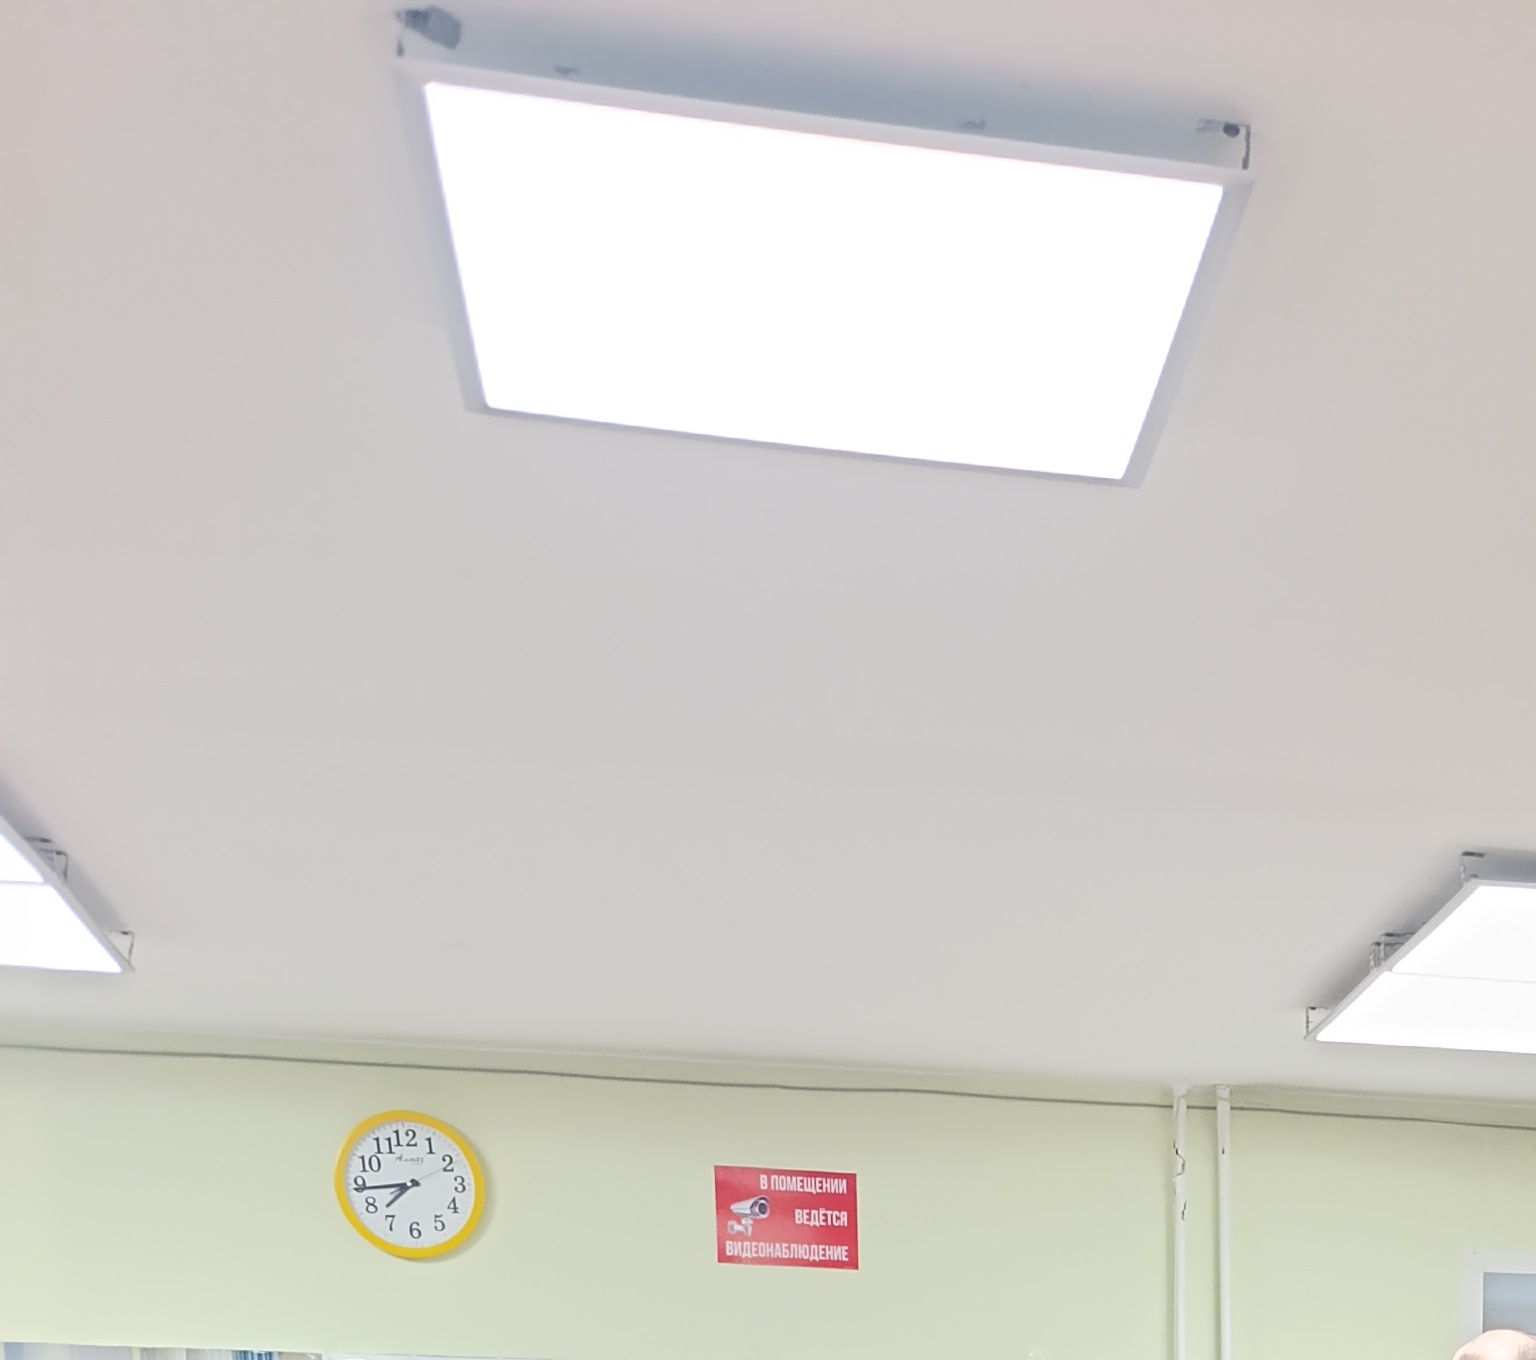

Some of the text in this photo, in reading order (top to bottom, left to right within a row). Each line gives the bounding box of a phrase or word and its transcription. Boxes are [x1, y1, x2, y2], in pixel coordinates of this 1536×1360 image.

[373, 1137, 396, 1154] 11
[393, 1129, 418, 1147] 12
[425, 1137, 436, 1154] 1
[358, 1154, 382, 1172] 10
[442, 1154, 454, 1172] 2
[353, 1175, 367, 1193] 9
[454, 1175, 466, 1193] 3
[759, 1174, 847, 1194] В ПОМЕЩЕНИИ
[365, 1196, 378, 1214] 8
[447, 1196, 460, 1214] 4
[385, 1214, 396, 1231] 7
[433, 1214, 446, 1231] 5
[794, 1208, 848, 1227] ВЕДЁТСЯ
[409, 1221, 422, 1239] 6
[725, 1241, 849, 1262] ВИДЕОНАБЛЮДЕНИЕ
